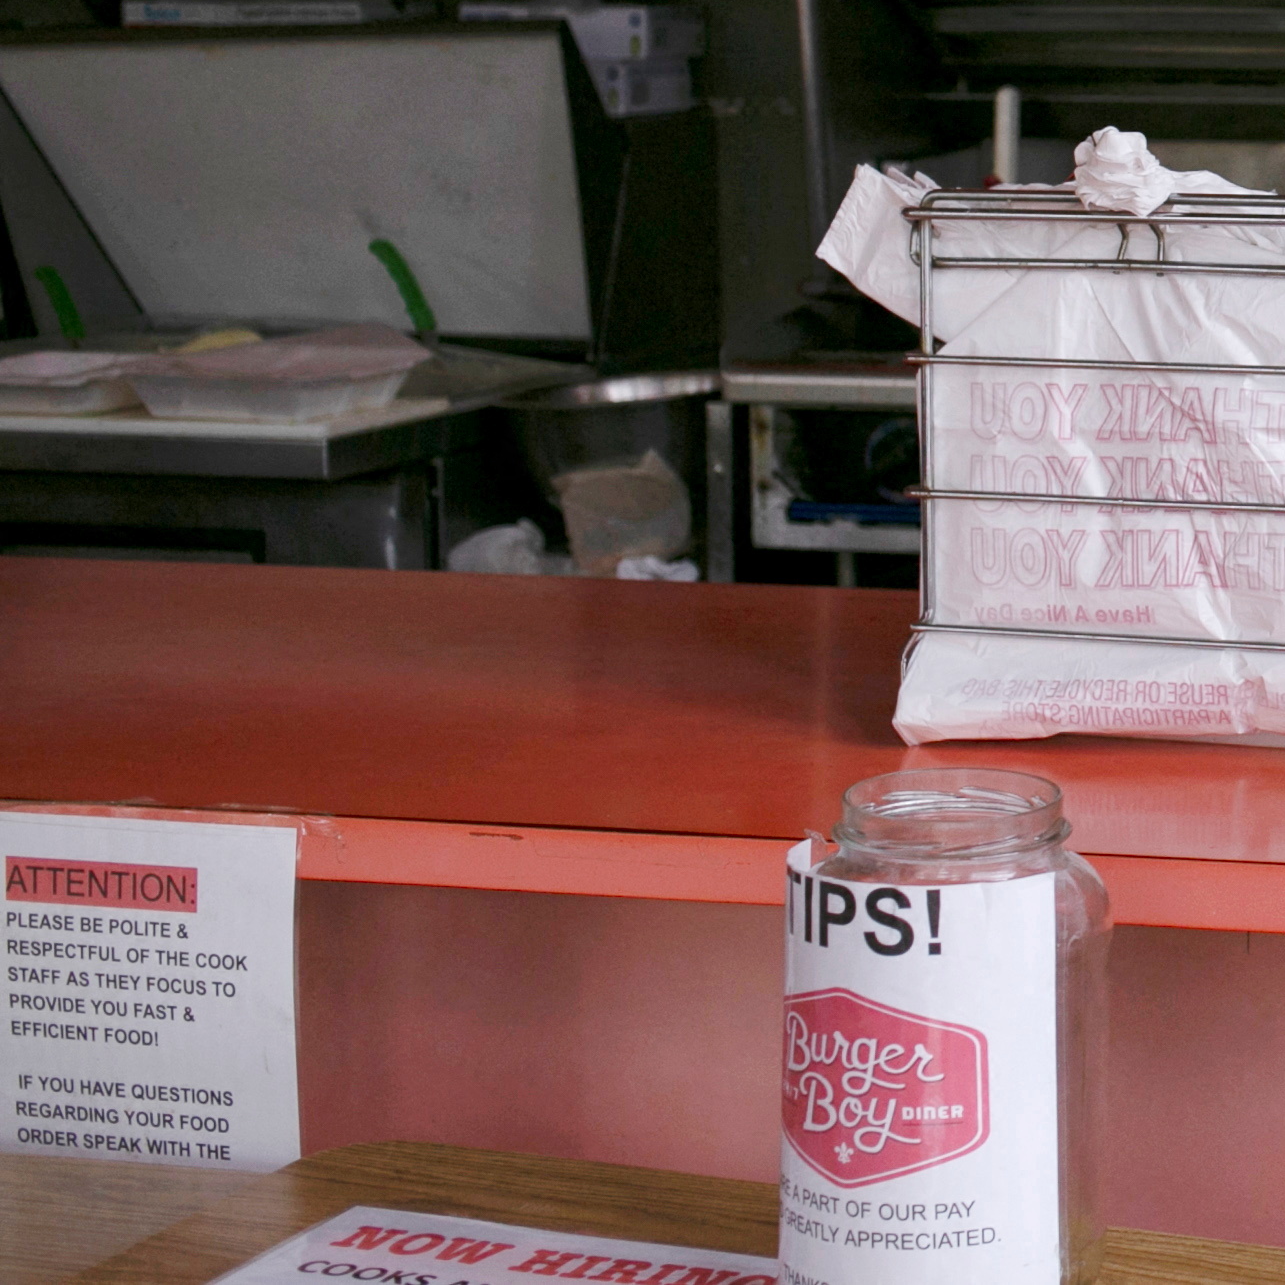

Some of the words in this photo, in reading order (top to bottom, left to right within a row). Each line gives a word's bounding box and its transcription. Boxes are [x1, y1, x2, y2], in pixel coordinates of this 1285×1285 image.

[6, 866, 196, 905] ATTENTION:
[6, 912, 75, 933] PLEASE
[80, 917, 104, 934] BE
[109, 919, 172, 939] POLITE
[176, 923, 189, 939] &
[789, 873, 943, 957] TIPS!
[6, 940, 121, 963] RESPECTFUL
[126, 948, 150, 964] OF
[155, 950, 190, 968] THE
[195, 953, 248, 971] COOK
[7, 967, 61, 985] STAFF
[66, 971, 90, 987] AS
[95, 973, 141, 992] THEY
[146, 977, 207, 996] FOCUS
[212, 981, 237, 998] TO
[9, 994, 86, 1014] PROVIDE
[90, 1000, 128, 1017] YOU
[134, 1003, 178, 1021] FAST
[183, 1007, 196, 1022] &
[11, 1021, 99, 1042] EFFICIENT
[104, 1029, 160, 1047] FOOD!
[785, 1011, 945, 1096] Burger
[18, 1074, 33, 1091] IF
[38, 1076, 75, 1094] YOU
[80, 1080, 126, 1098] HAVE
[131, 1084, 234, 1107] QUESTIONS
[15, 1101, 120, 1125] REGARDING
[124, 1110, 175, 1129] YOUR
[180, 1114, 230, 1134] FOOD
[800, 1070, 923, 1155] Boy
[901, 1104, 965, 1122] DINER
[17, 1127, 79, 1148] ORDER
[83, 1134, 142, 1154] SPEAK
[146, 1138, 191, 1158] WITH
[196, 1144, 231, 1161] THE
[802, 1188, 840, 1215] PART
[845, 1199, 872, 1218] OF
[878, 1202, 926, 1221] OUR
[934, 1200, 976, 1220] PAY
[330, 1225, 516, 1265] NOW
[784, 1207, 840, 1244] GREATLY
[844, 1226, 1003, 1251] APPRECIATED.
[296, 1259, 438, 1285] COOKS
